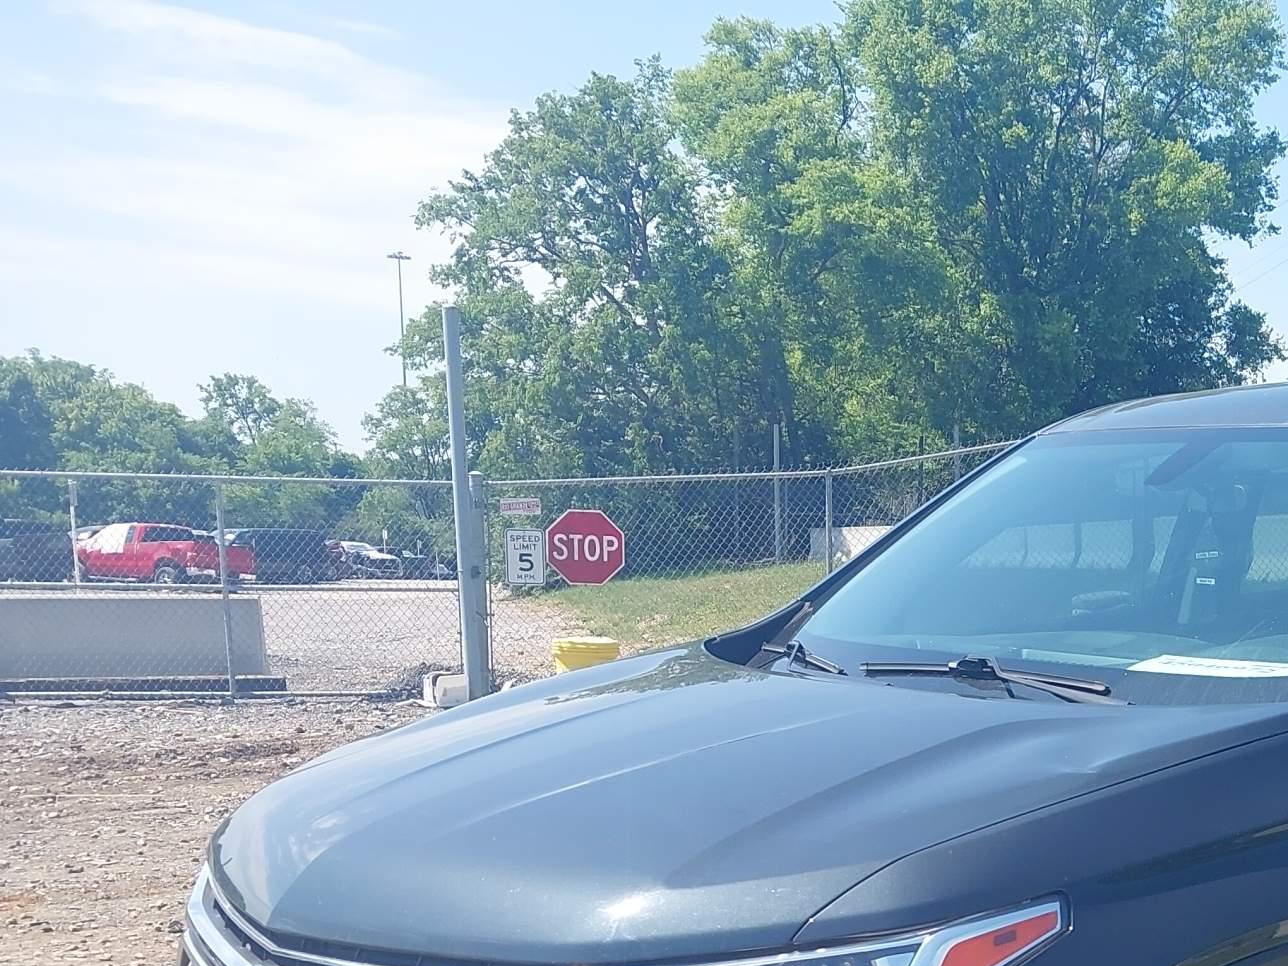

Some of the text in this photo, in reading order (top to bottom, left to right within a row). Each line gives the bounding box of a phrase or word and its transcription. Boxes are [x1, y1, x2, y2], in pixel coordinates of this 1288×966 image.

[513, 543, 538, 551] LIMIT
[552, 534, 619, 562] STOP
[519, 553, 534, 571] 5
